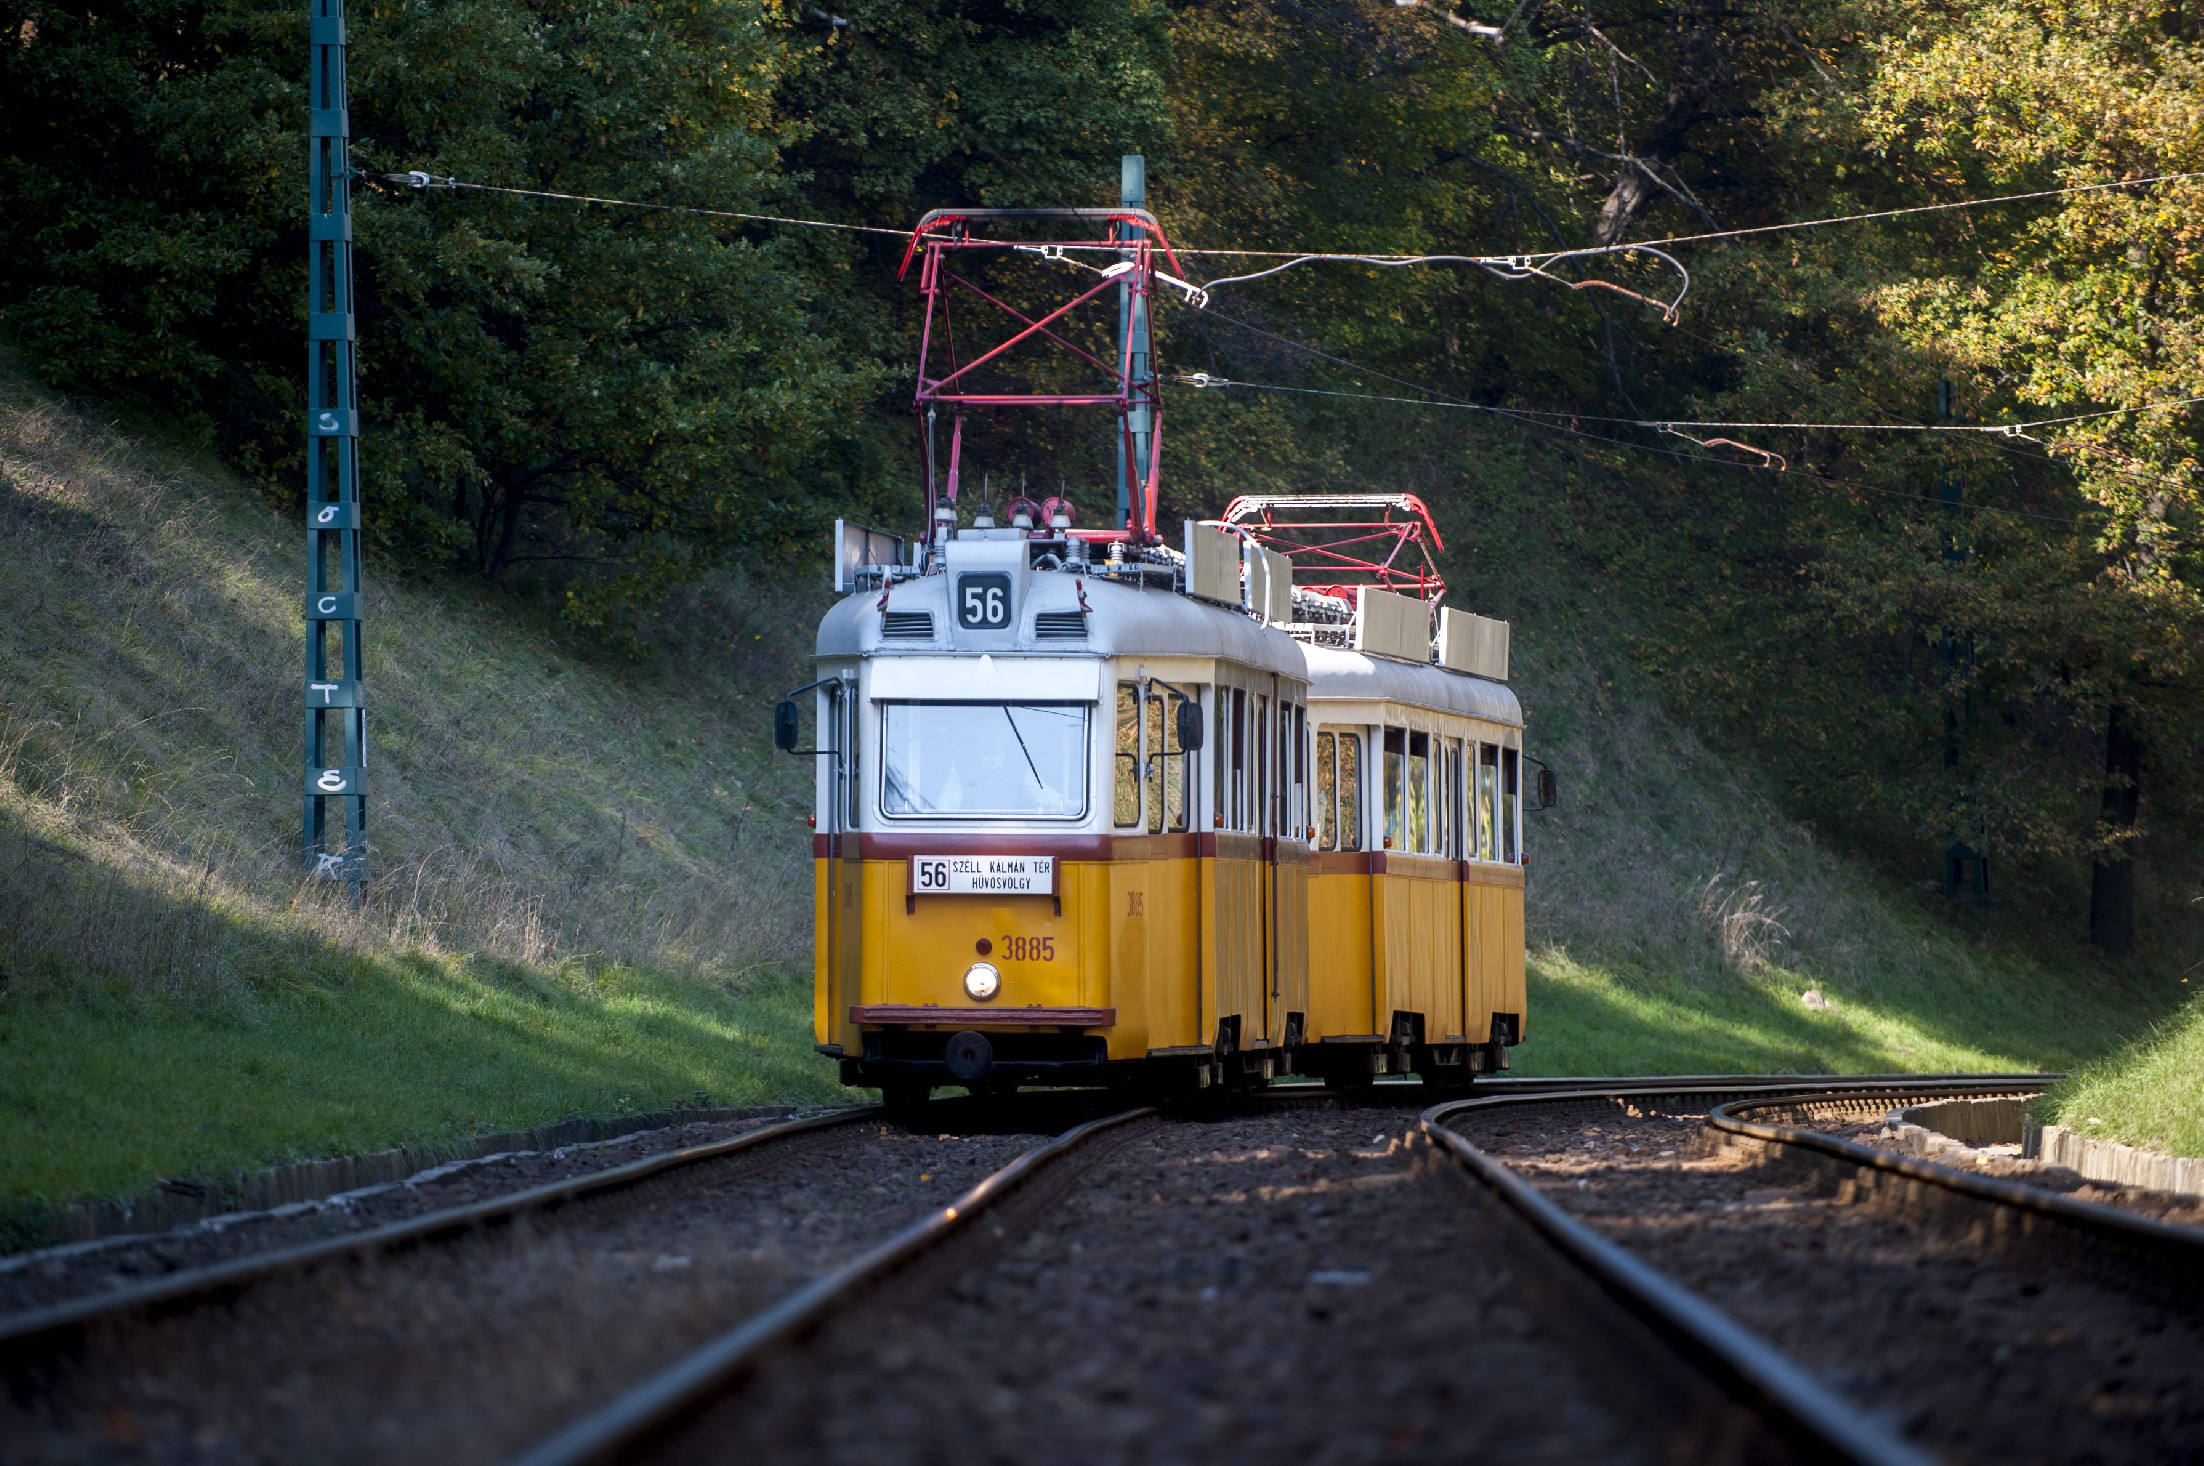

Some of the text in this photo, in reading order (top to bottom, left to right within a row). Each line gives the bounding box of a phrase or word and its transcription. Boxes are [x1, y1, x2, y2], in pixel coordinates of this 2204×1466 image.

[965, 586, 1004, 624] 56
[920, 861, 947, 888] 56
[952, 859, 1050, 873] SZÉLL KÁLMÁN TÉR
[1001, 934, 1055, 962] 3885
